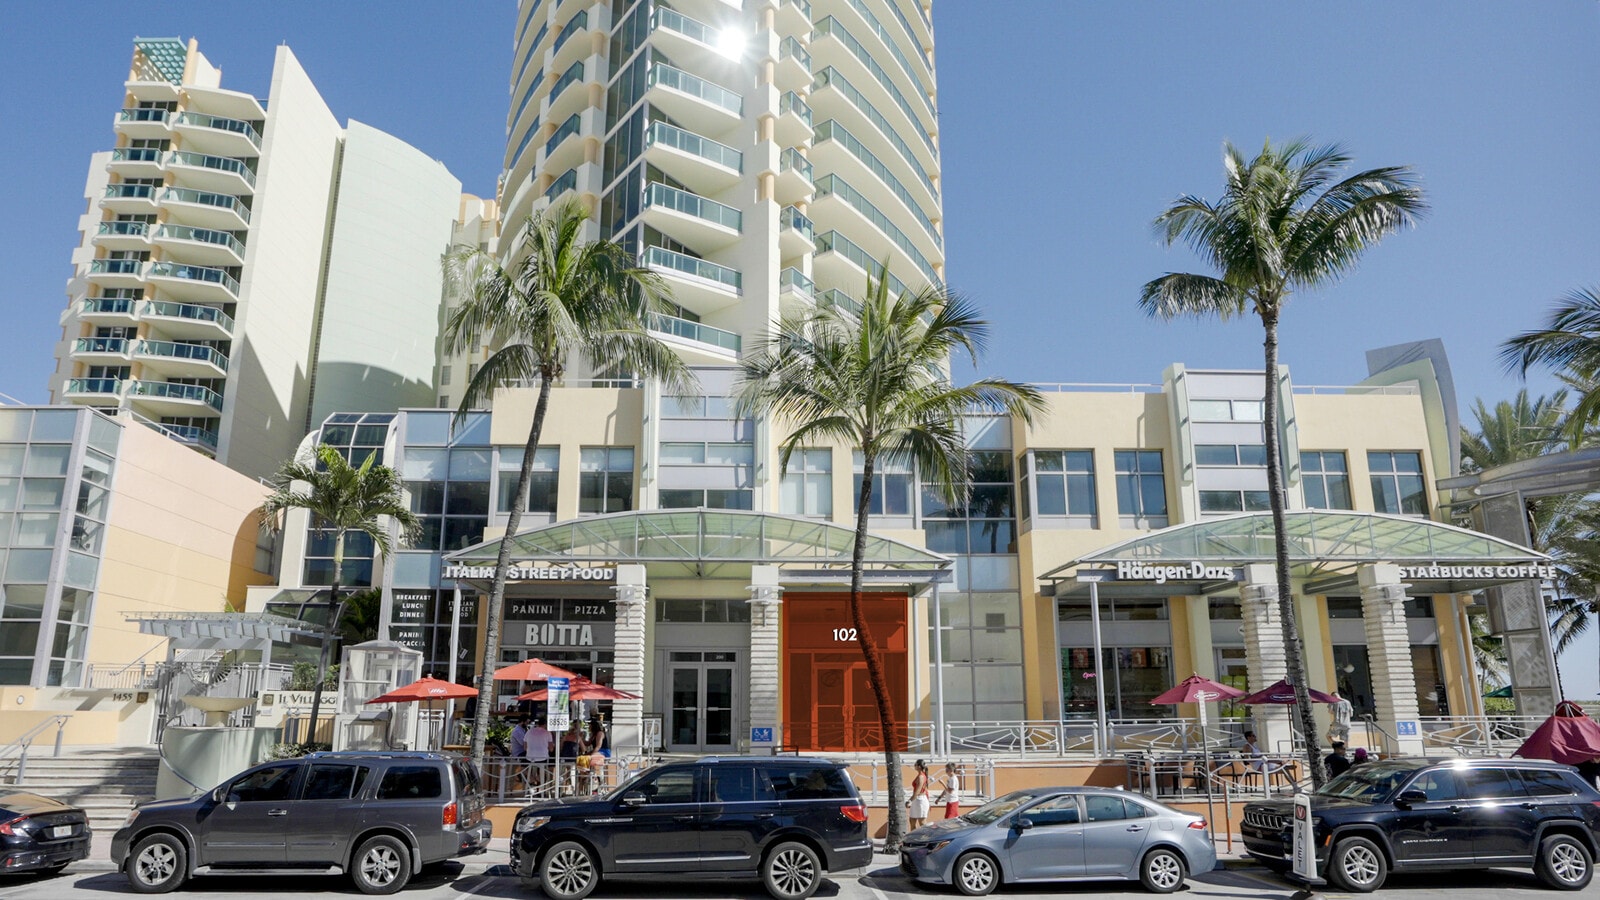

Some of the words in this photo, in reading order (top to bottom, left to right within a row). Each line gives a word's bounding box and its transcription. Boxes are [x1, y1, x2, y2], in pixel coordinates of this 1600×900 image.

[445, 565, 498, 578] ITALIA
[509, 566, 565, 580] STREET
[572, 567, 613, 580] FOOD
[1117, 561, 1236, 584] Häagen-Dazs
[1398, 566, 1494, 579] STARBUCKS
[1496, 566, 1557, 579] COFFEE
[512, 604, 553, 614] PANINI
[574, 605, 606, 614] PIZZA
[525, 623, 593, 646] BOTTA
[112, 692, 133, 702] 1455
[1297, 806, 1304, 819] V
[1296, 821, 1304, 868] VALET
